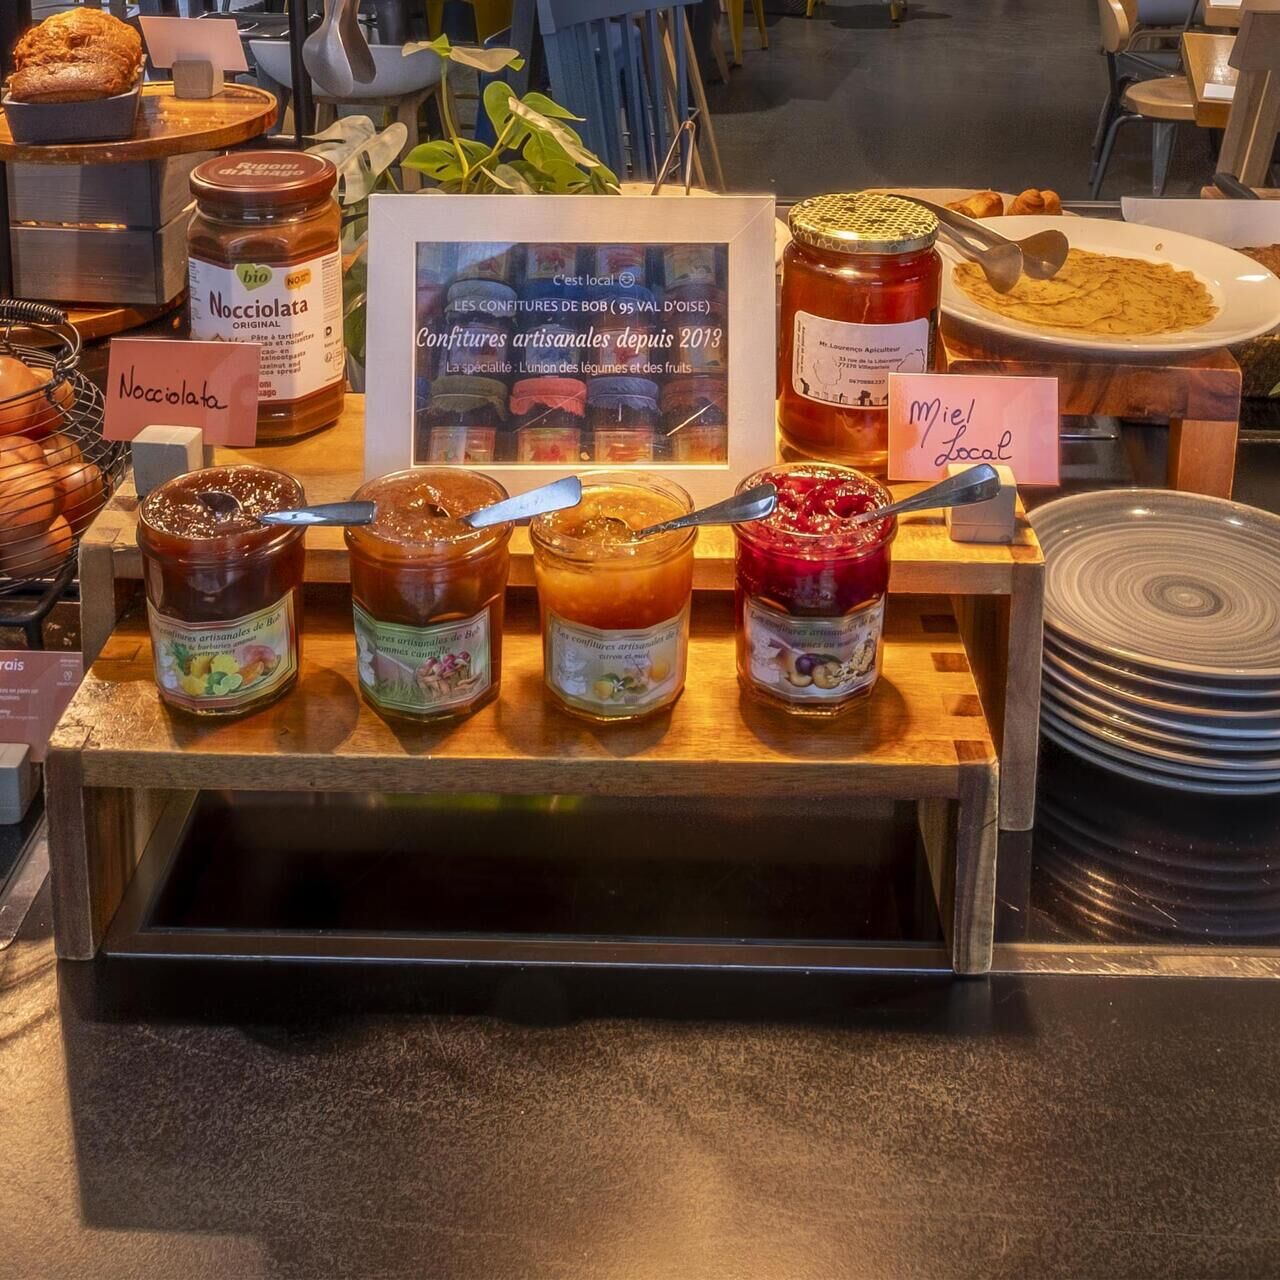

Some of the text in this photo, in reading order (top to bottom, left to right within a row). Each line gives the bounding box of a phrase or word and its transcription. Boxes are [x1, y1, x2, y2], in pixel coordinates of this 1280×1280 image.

[236, 162, 300, 171] Rigoni
[238, 169, 305, 177] Asiago
[243, 270, 268, 283] bio
[553, 273, 614, 286] C'est local
[209, 290, 308, 318] Nocciolata
[454, 300, 476, 312] LES
[479, 300, 558, 313] CONFITURES
[561, 300, 578, 312] DE
[581, 300, 608, 312] BOB
[619, 303, 634, 315] 95
[637, 301, 661, 312] VAL
[664, 300, 710, 314] D'OISE)
[233, 321, 280, 329] ORIGINAL
[416, 326, 722, 353] Confitures artisanales depuis 2013
[830, 343, 862, 353] Lourenço
[446, 362, 460, 373] La
[461, 362, 512, 376] spécialité
[520, 362, 557, 373] L'union
[559, 362, 578, 373] des
[581, 362, 628, 376] légumes
[630, 363, 641, 373] et
[644, 362, 662, 373] des
[665, 362, 691, 373] fruits
[120, 365, 228, 410] Nocciolata
[909, 397, 976, 448] Miel
[935, 424, 1012, 467] Local
[200, 629, 250, 643] artisanales
[253, 622, 263, 632] de
[398, 636, 448, 647] artisanales
[451, 631, 462, 640] de
[572, 635, 615, 650] confitures
[618, 635, 664, 650] artisanales
